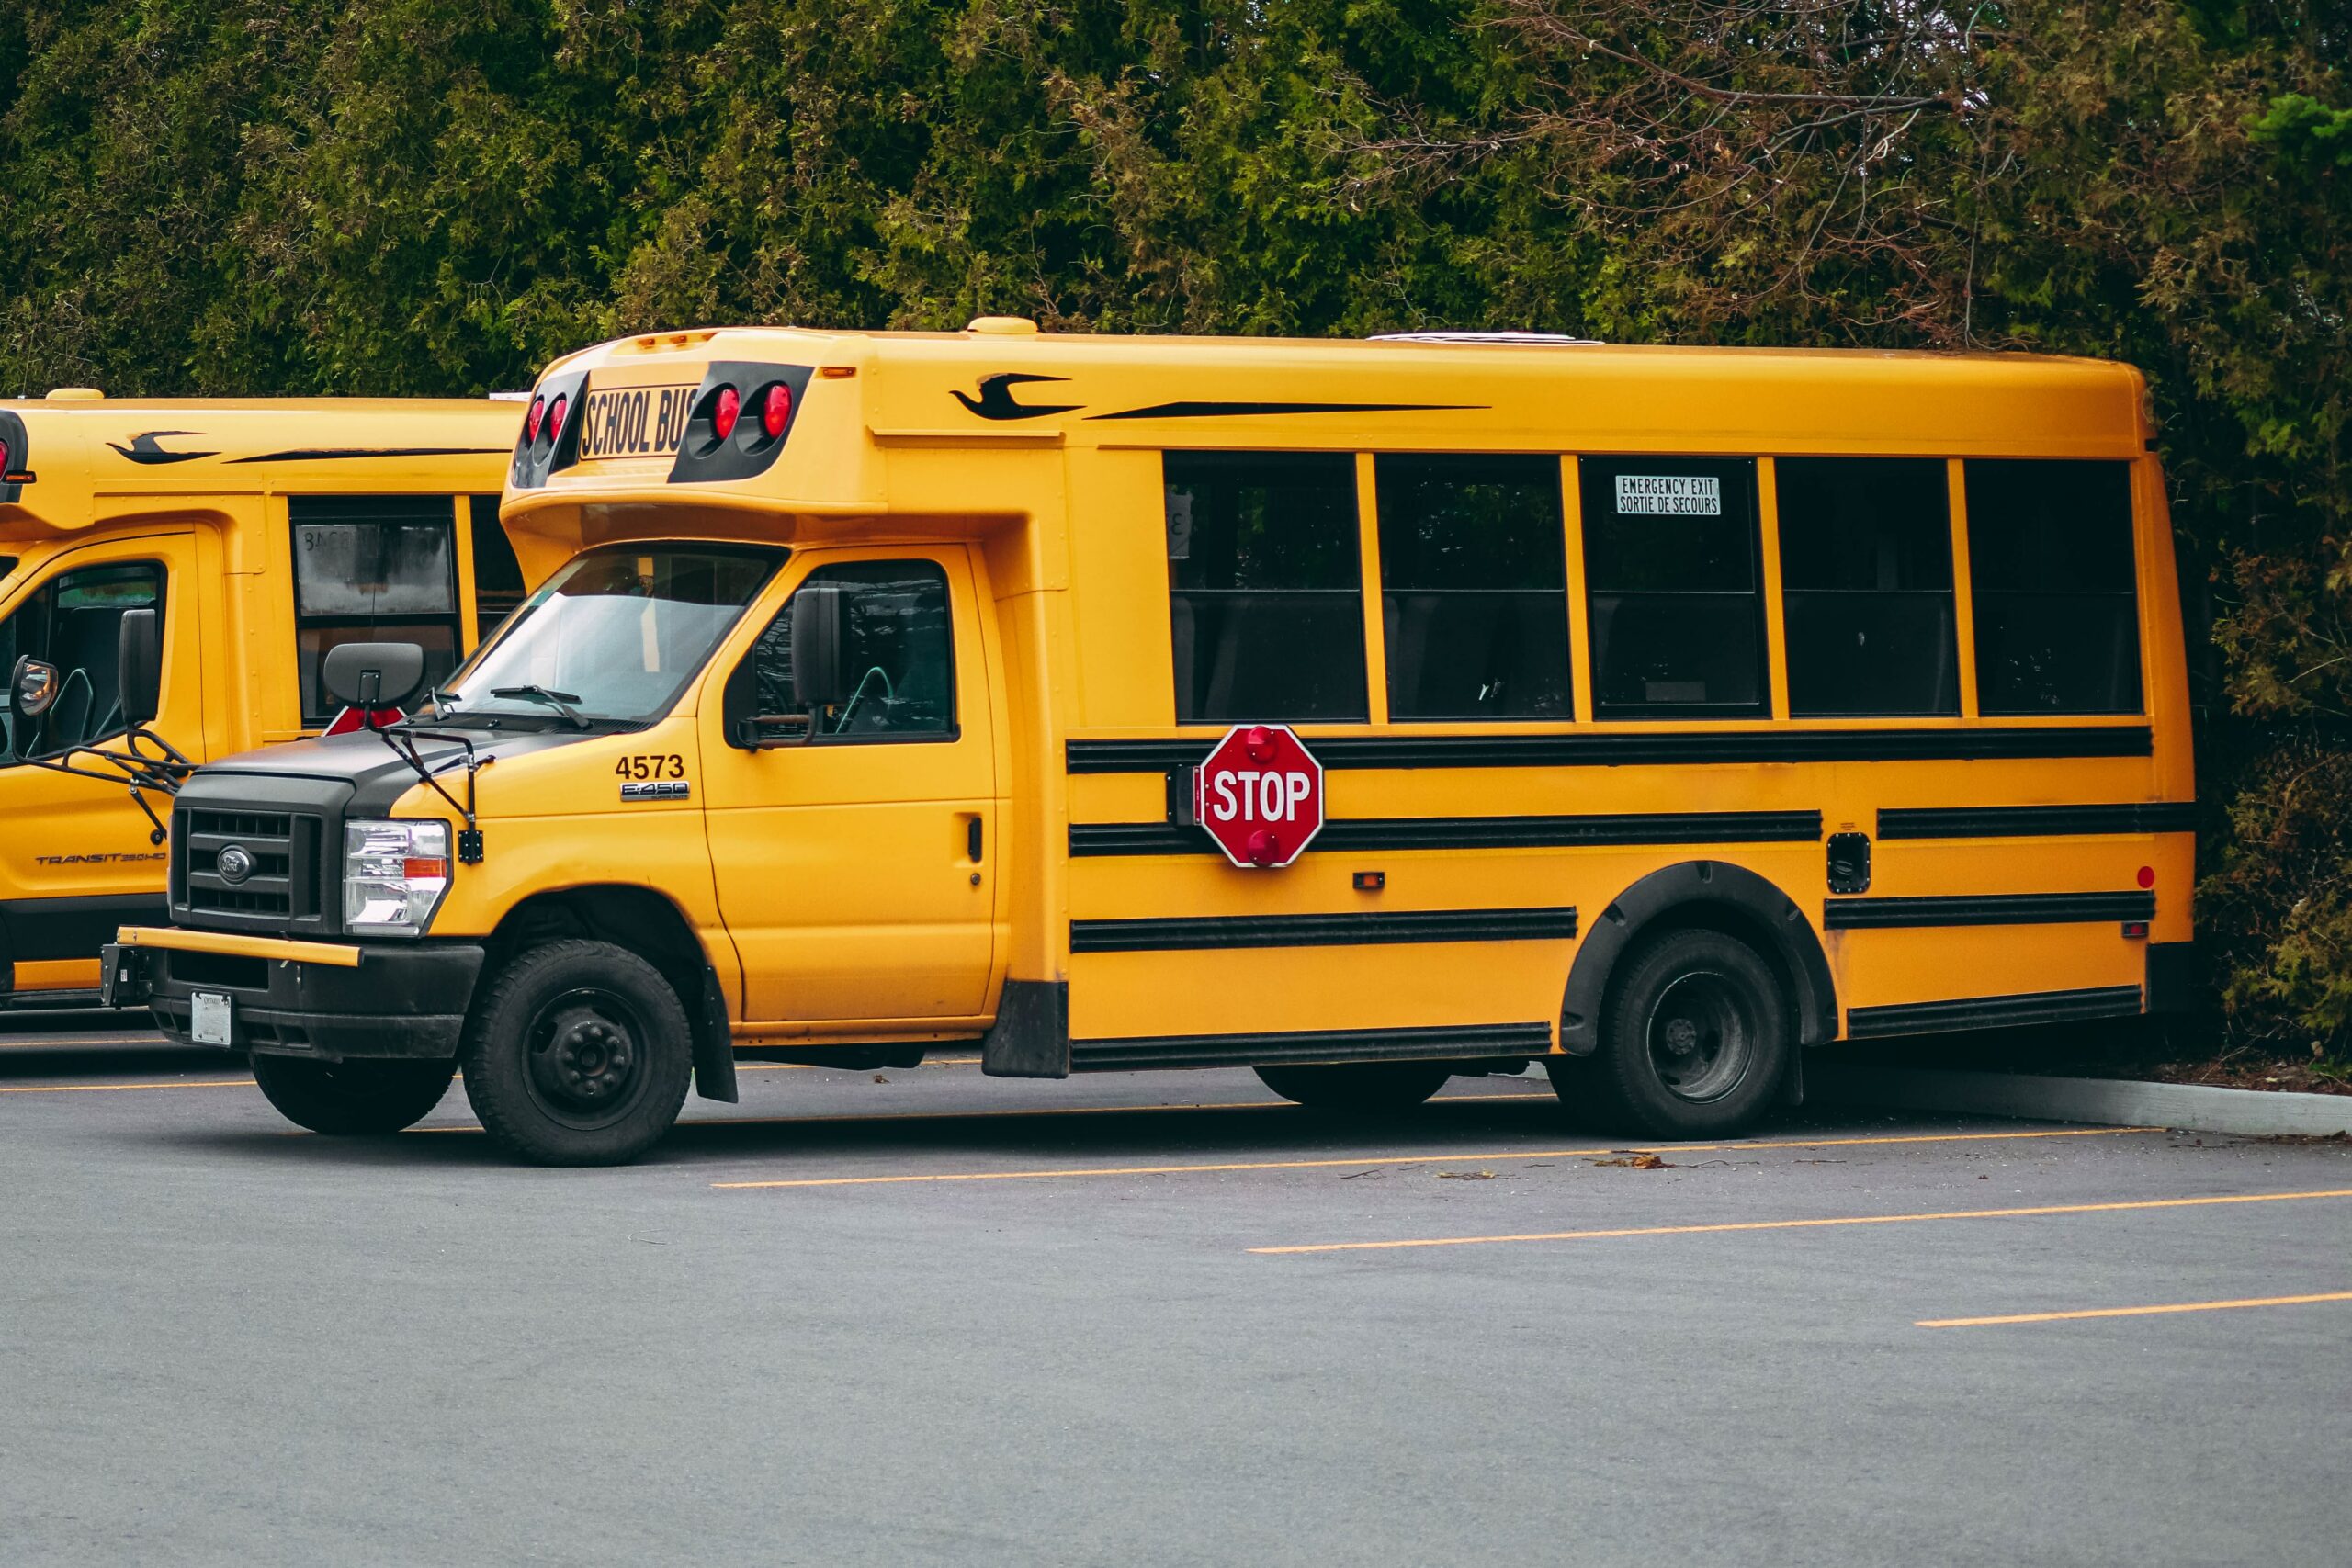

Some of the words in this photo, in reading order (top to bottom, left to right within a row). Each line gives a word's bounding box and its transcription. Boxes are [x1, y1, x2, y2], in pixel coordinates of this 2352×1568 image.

[582, 391, 650, 456] SCHOOL
[1622, 478, 1686, 495] EMERGENCY
[1691, 479, 1713, 496] EXIT
[1620, 496, 1654, 513] SORTIE
[1657, 497, 1670, 513] DE
[1673, 497, 1717, 513] SECOURS
[616, 754, 684, 779] 4573
[1213, 770, 1311, 822] STOP
[35, 852, 121, 865] TRANSIT
